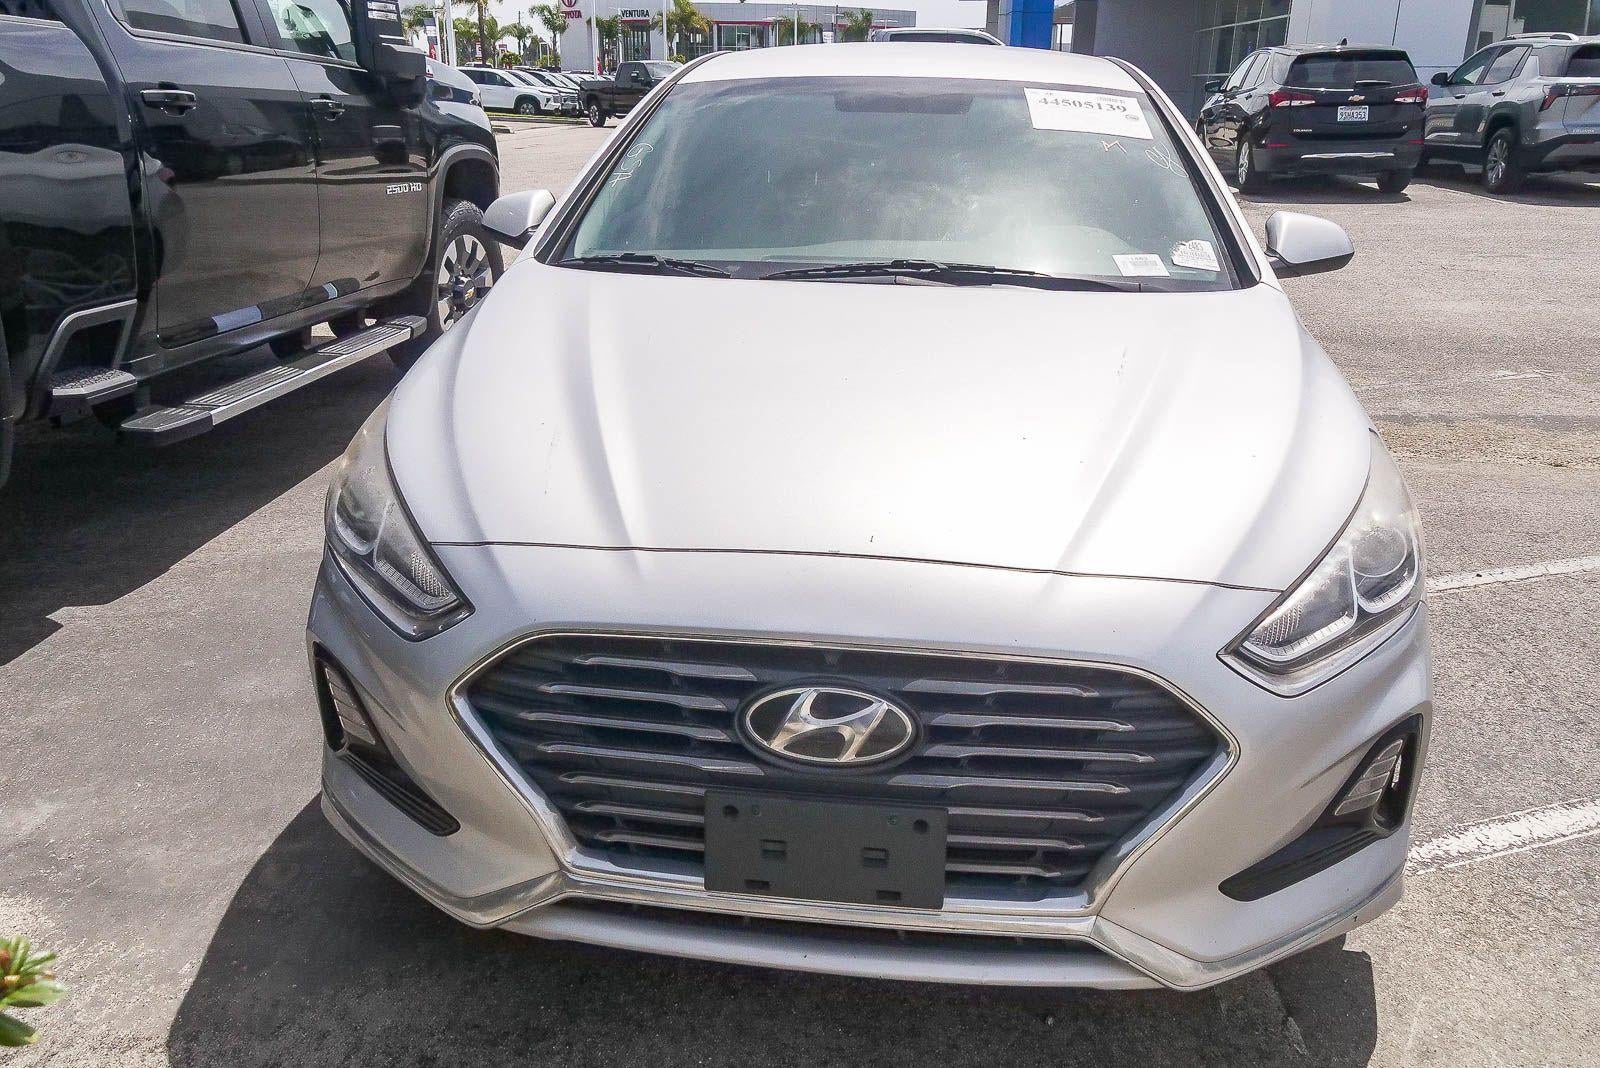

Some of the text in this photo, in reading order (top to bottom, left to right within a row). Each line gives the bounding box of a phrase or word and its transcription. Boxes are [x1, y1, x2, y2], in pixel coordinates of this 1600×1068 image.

[621, 9, 650, 17] VENTURA
[1038, 97, 1127, 113] 44505139
[386, 182, 422, 195] 2500 HD
